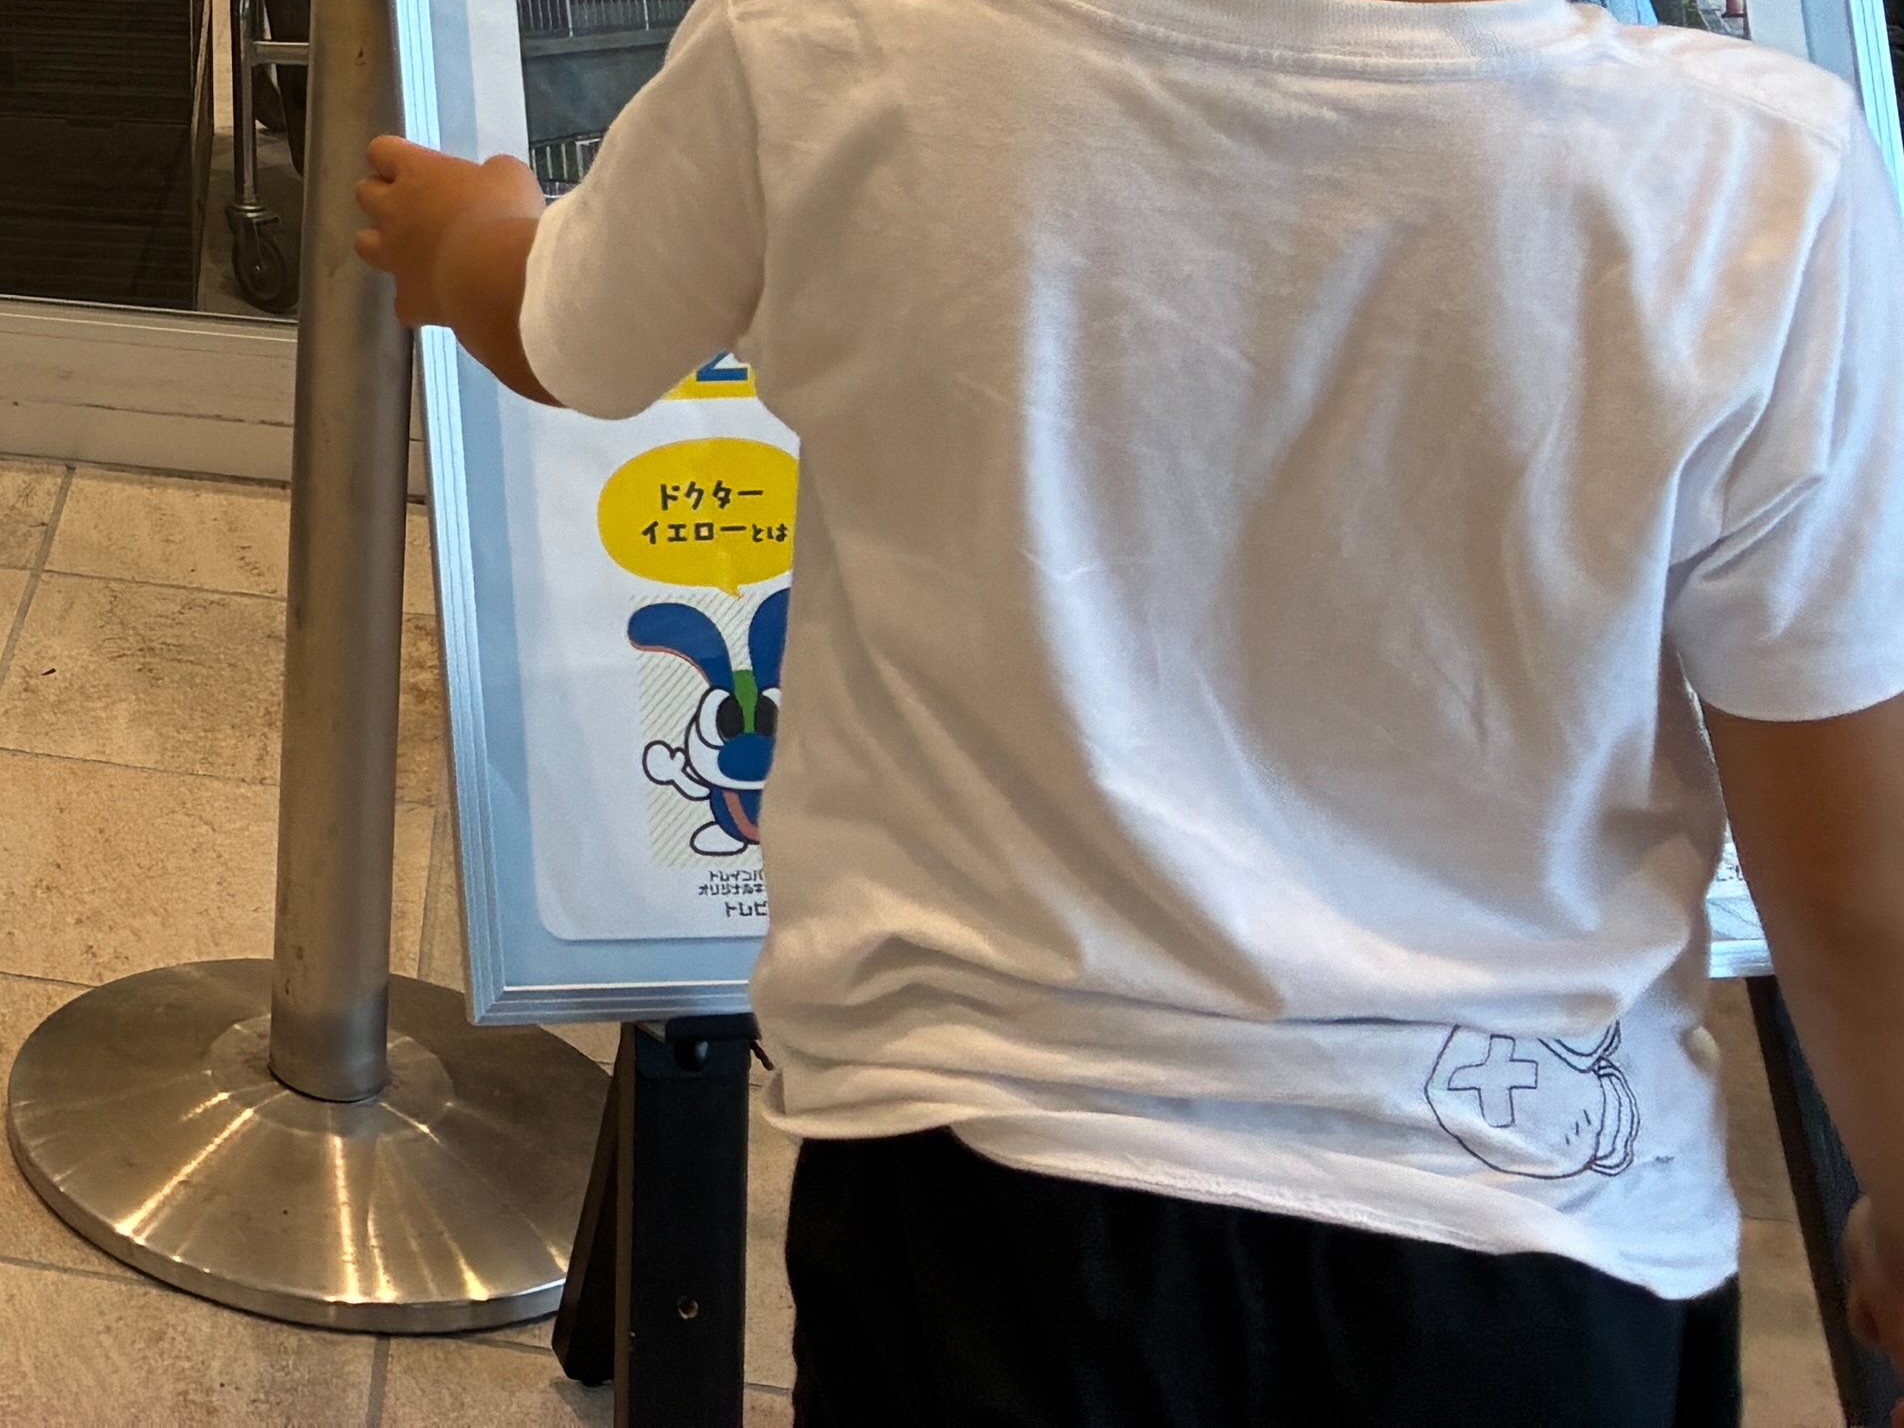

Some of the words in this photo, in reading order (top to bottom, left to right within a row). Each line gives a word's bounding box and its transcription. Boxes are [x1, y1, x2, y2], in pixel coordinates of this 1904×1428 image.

[660, 481, 764, 512] ドクター
[641, 520, 788, 544] イエローとは
